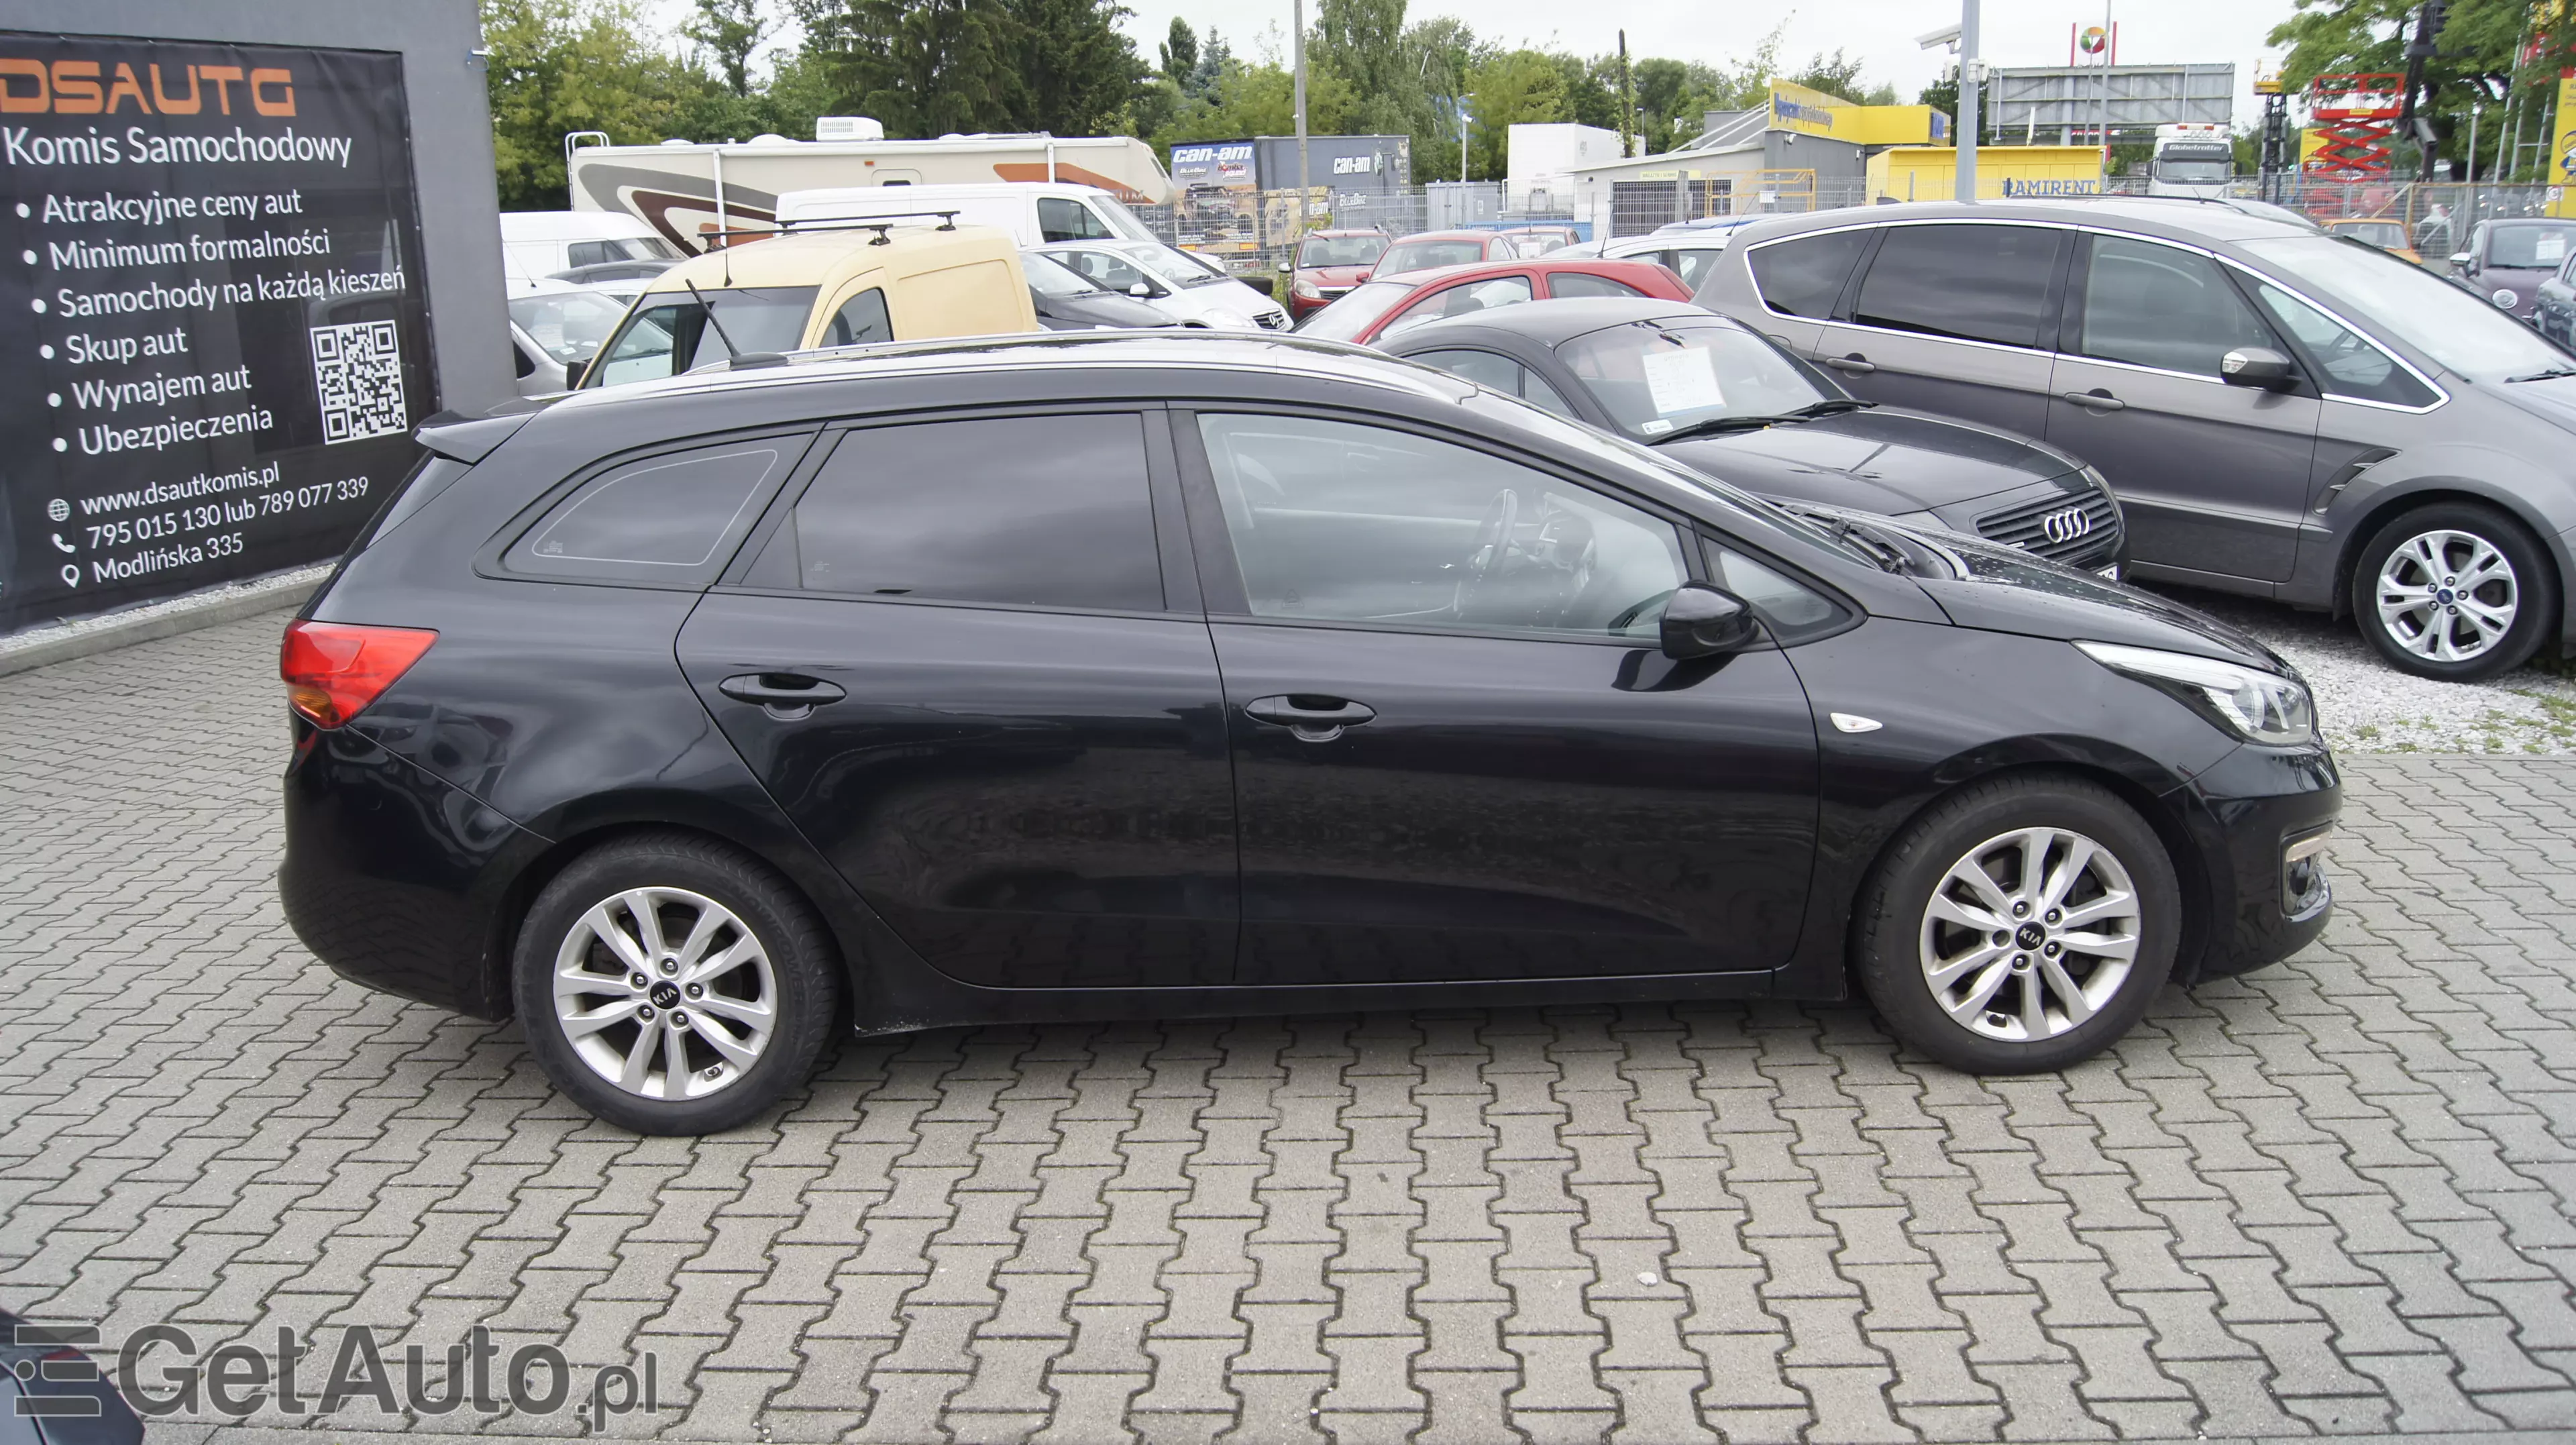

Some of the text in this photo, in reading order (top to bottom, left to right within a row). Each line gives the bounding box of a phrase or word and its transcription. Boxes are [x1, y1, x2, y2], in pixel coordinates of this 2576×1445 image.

[3, 126, 352, 168] Komis Samochodowy
[1173, 146, 1252, 163] can-am
[1333, 156, 1371, 174] can-am
[2169, 144, 2224, 152] Globetrotter
[2002, 179, 2096, 196] RAMIRENT
[42, 189, 303, 225] Atrakcyjne ceny aut
[1299, 202, 1329, 217] n-am
[48, 229, 331, 271] Minimum formalności
[58, 264, 406, 318] Samochody na każdą kieszeń
[66, 327, 189, 365] Skup aut
[71, 364, 252, 412] Wynajem aut
[78, 405, 274, 456] Ubezpieczenia
[79, 462, 280, 516] www.dsautkomis.pl
[86, 476, 369, 549] 795 015 130 lub 789 077 339
[93, 533, 244, 583] Modlińska 335
[2019, 927, 2042, 947] KIA
[652, 987, 678, 1005] KIA
